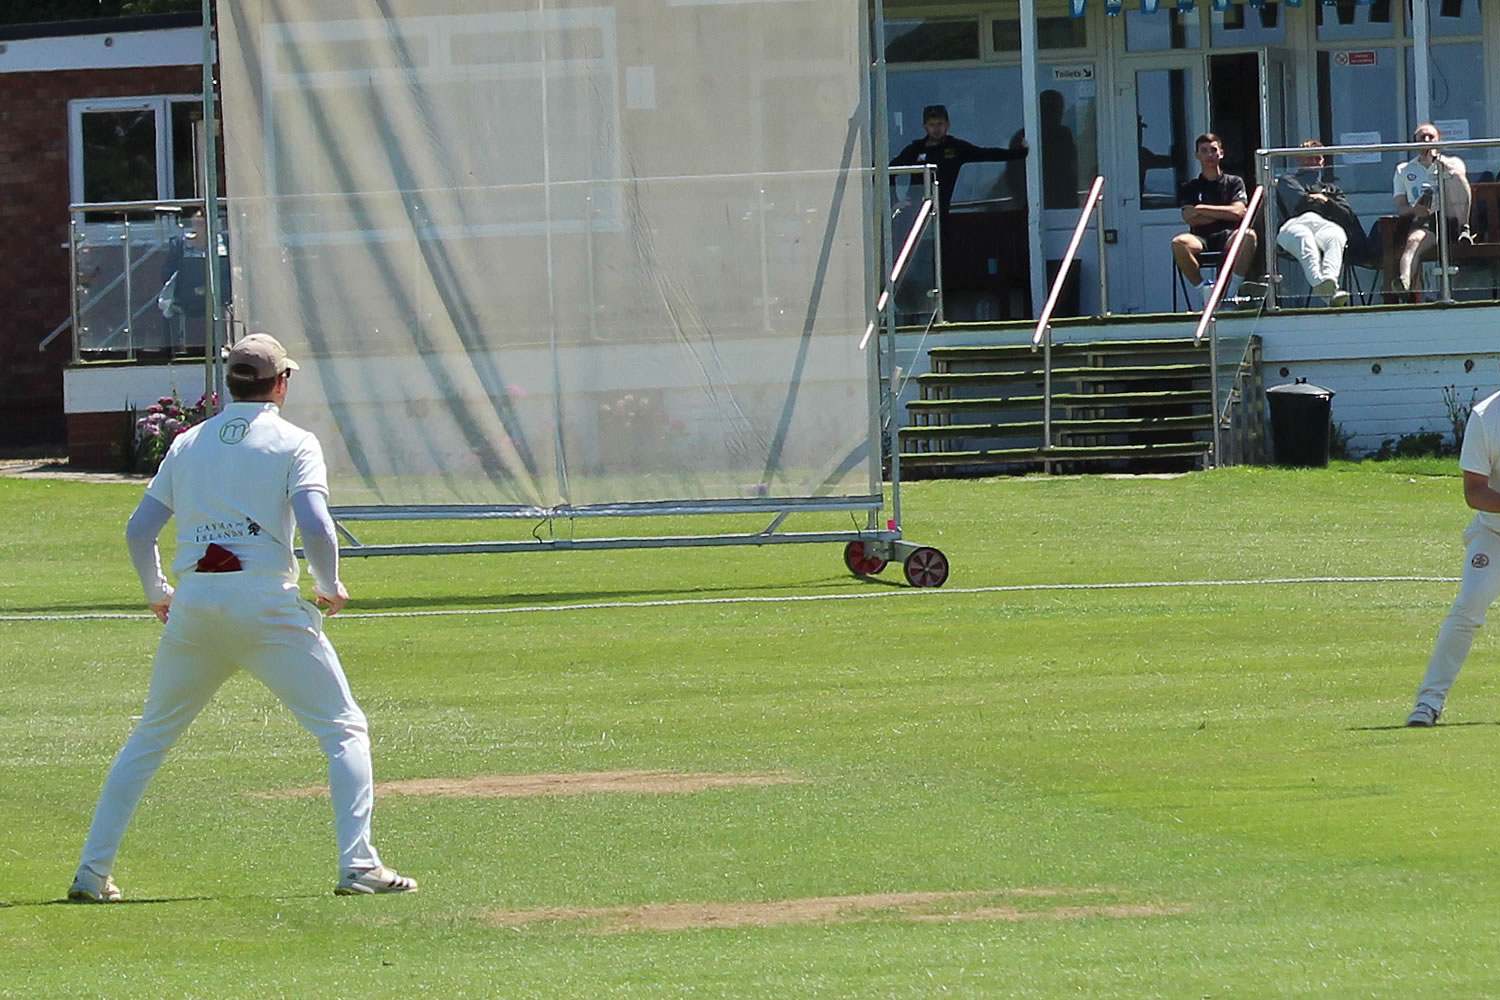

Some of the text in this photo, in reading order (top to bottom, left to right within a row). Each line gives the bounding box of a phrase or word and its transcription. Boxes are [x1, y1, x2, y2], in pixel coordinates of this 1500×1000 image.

[1055, 69, 1082, 78] Toilets
[196, 521, 244, 533] CAYMAN
[196, 529, 244, 542] ISLANDS
